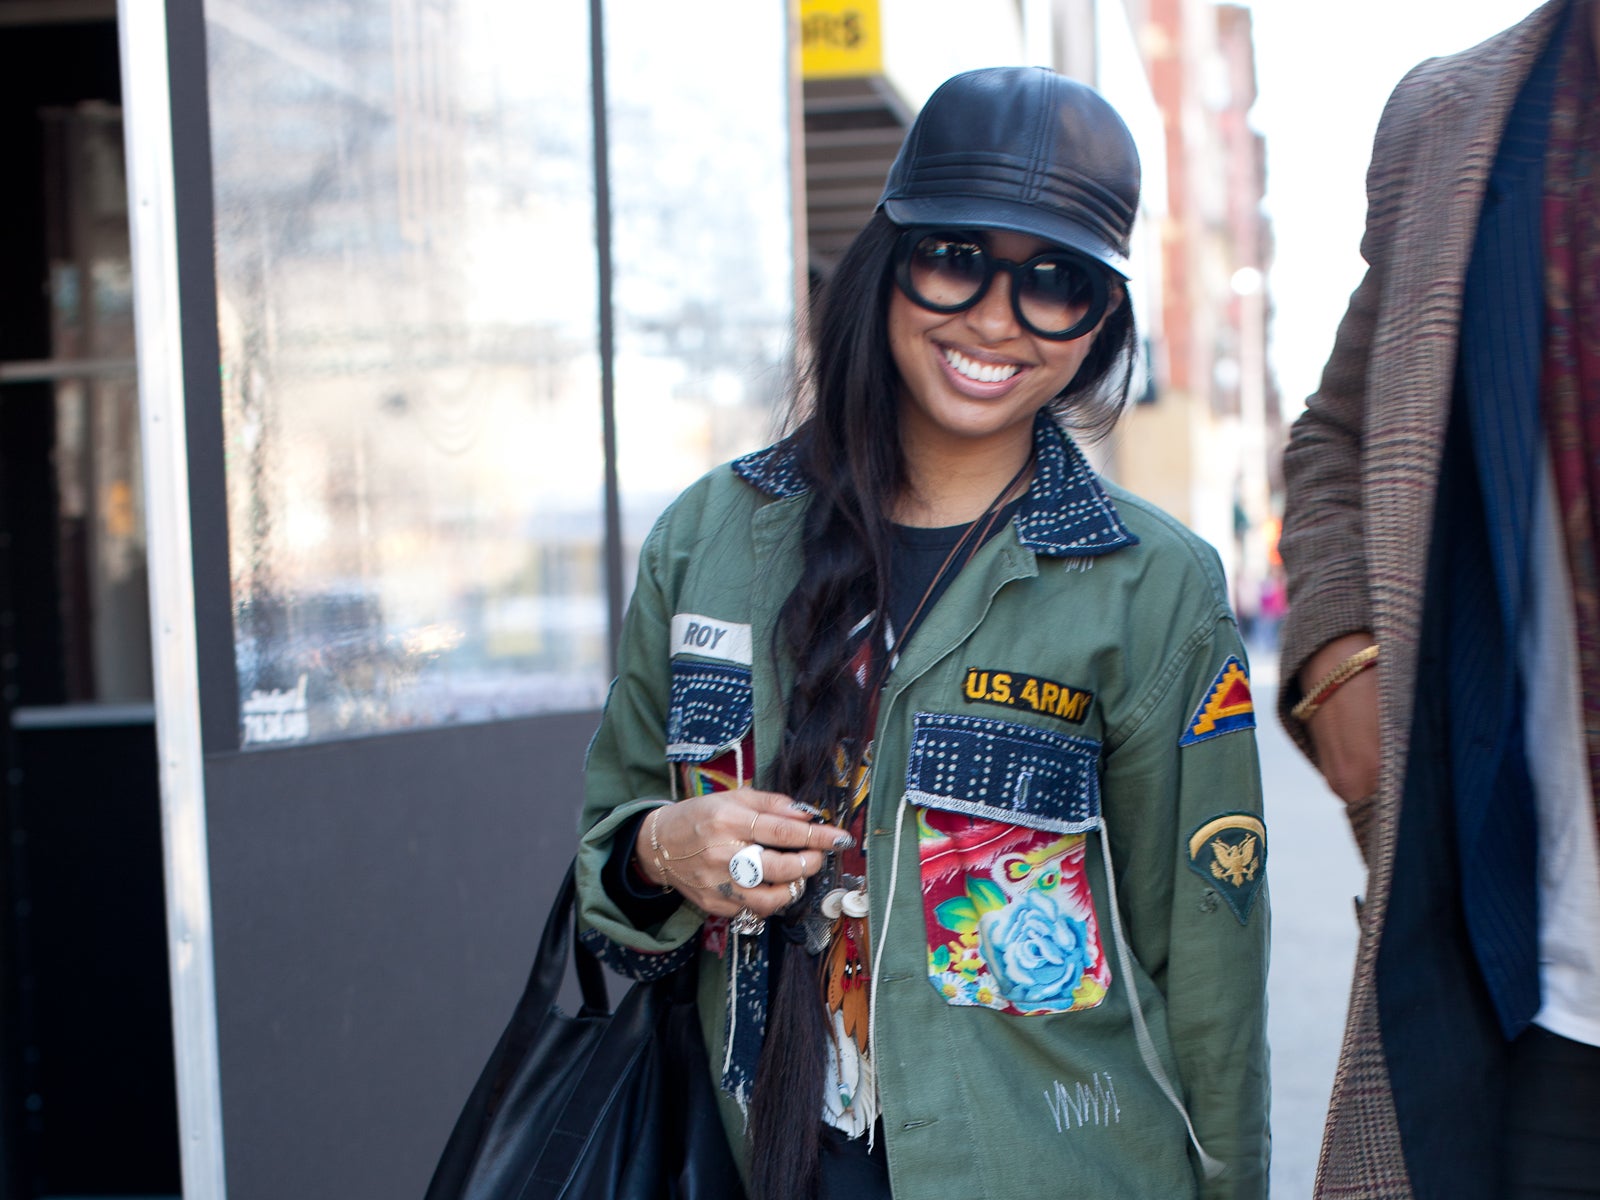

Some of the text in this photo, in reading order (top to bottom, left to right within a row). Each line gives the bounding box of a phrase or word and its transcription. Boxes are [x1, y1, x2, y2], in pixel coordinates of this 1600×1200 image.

[683, 622, 727, 650] ROY
[966, 672, 1091, 721] U.S. ARMY
